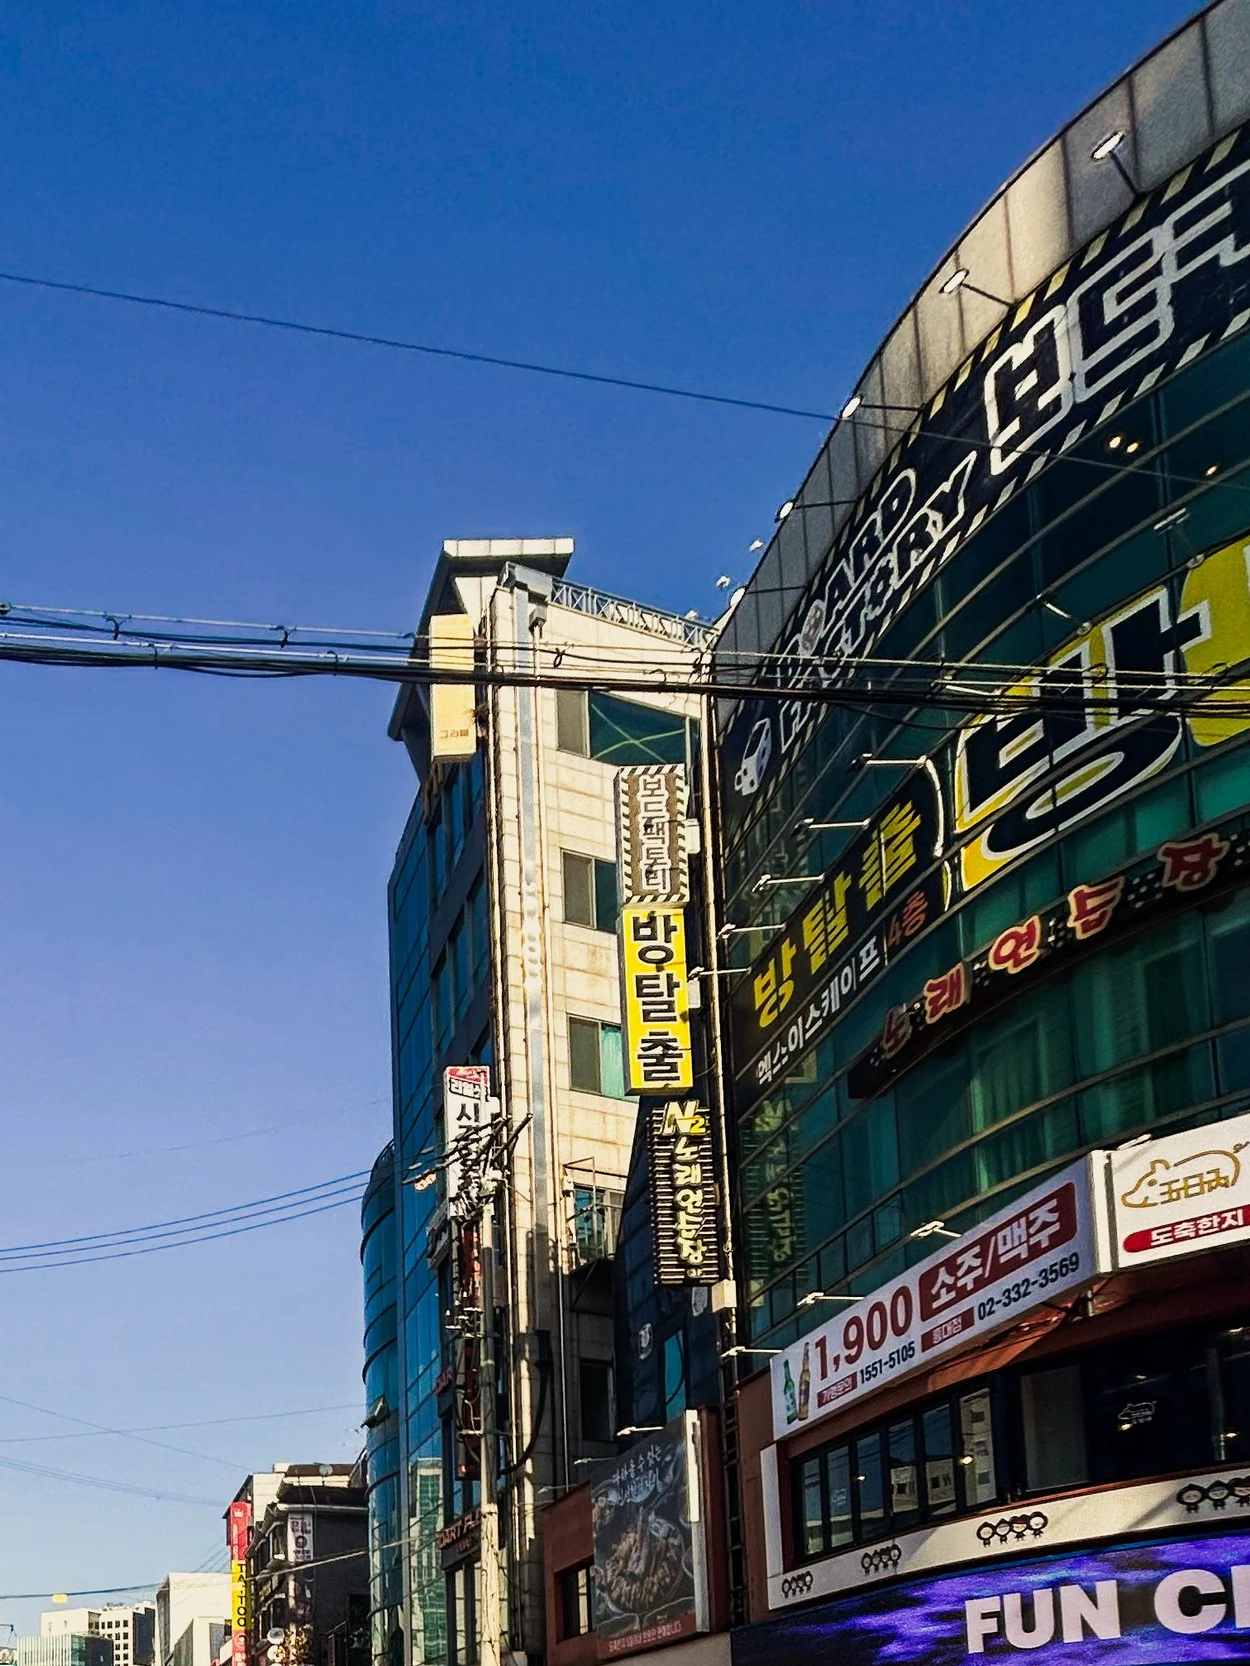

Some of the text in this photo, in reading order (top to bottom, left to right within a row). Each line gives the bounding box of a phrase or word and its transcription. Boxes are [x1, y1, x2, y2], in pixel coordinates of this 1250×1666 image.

[955, 545, 1250, 862] 방
[754, 800, 923, 1029] 방탈출
[632, 912, 684, 1083] 방탈출
[660, 1100, 707, 1136] N2
[673, 1136, 708, 1265] 노래연습장
[1150, 1208, 1245, 1247] 도축한지
[929, 1198, 1062, 1310] 소주/맥주
[977, 1252, 1080, 1321] 02-332-3569
[814, 1285, 913, 1381] 1,900
[859, 1340, 916, 1384] 1551-5105
[965, 1580, 1121, 1654] FUN
